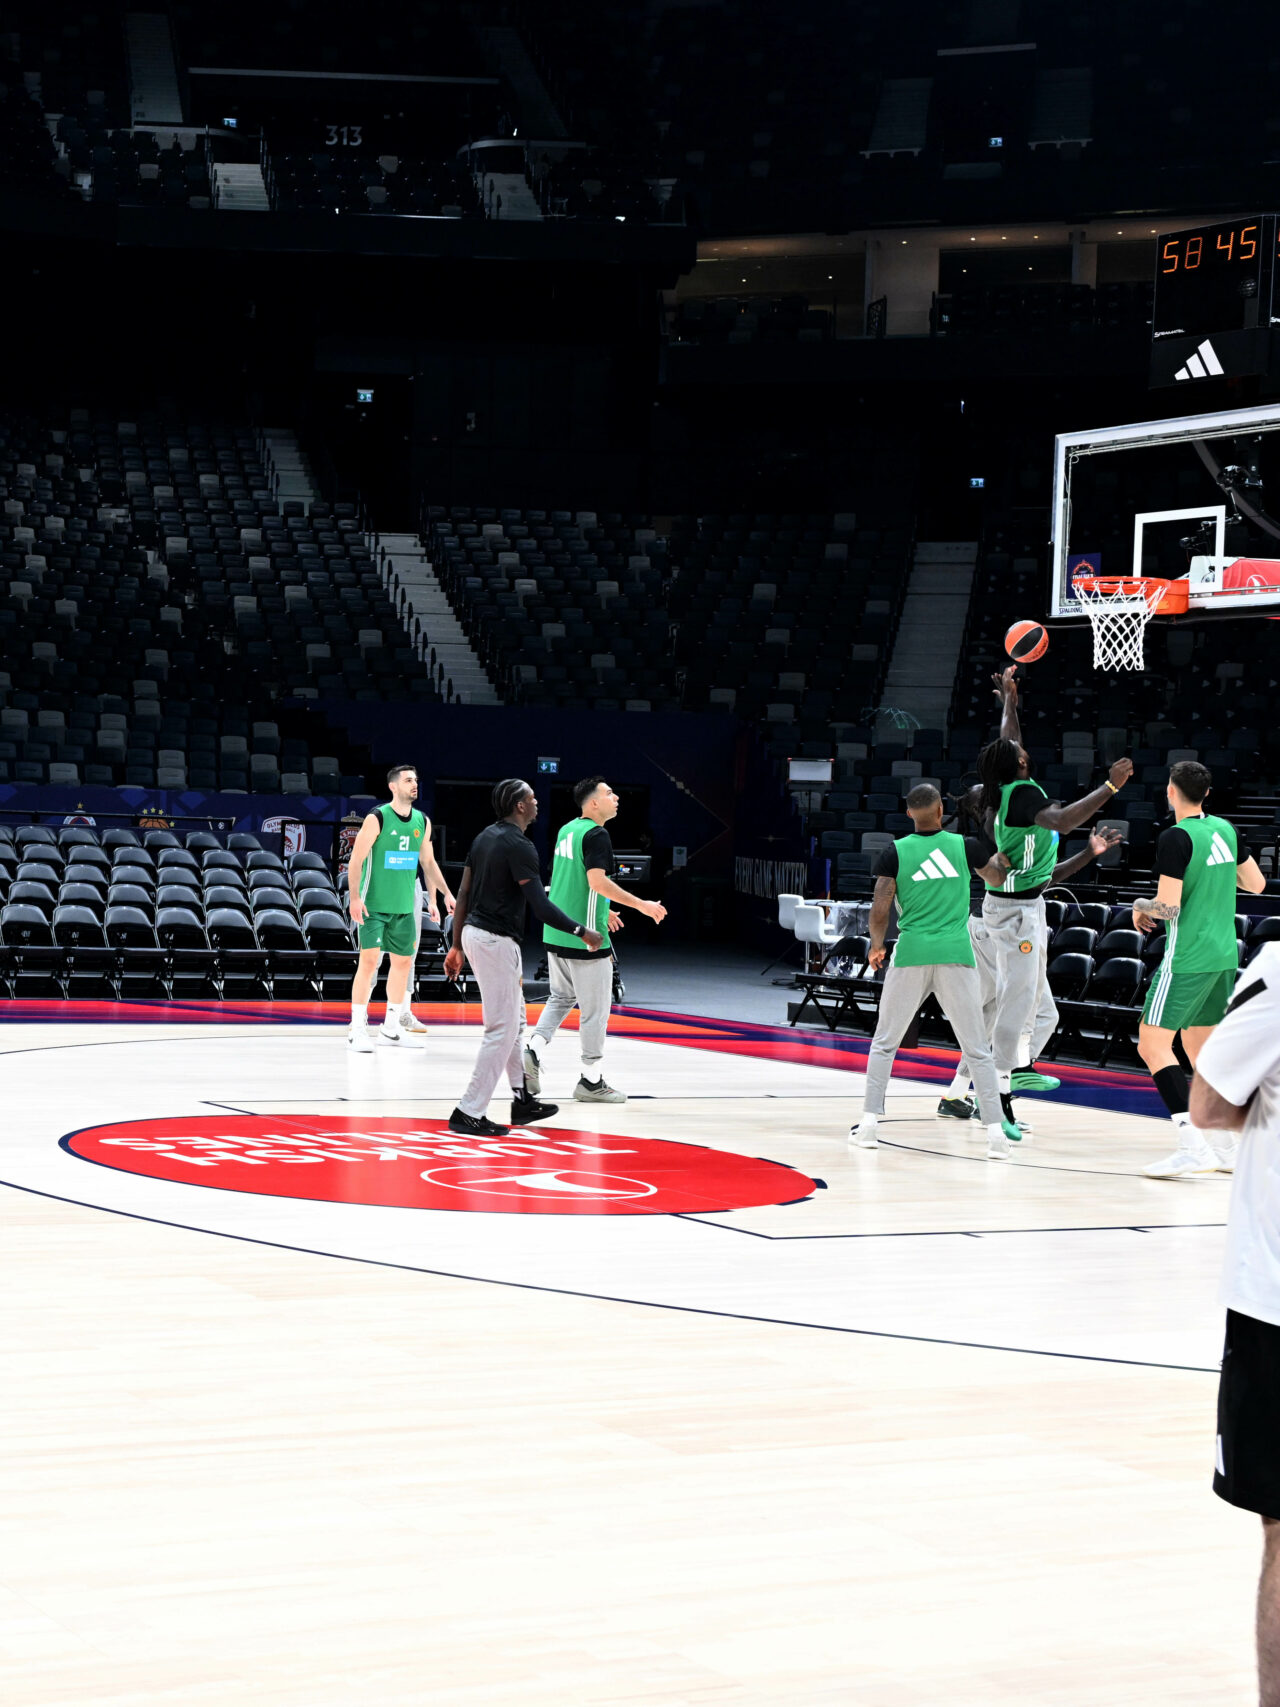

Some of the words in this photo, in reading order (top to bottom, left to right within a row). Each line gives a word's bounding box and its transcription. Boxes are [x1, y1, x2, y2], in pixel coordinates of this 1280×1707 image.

[326, 125, 362, 146] 313
[1163, 237, 1203, 273] 58
[1217, 226, 1257, 262] 45
[399, 836, 410, 851] 21
[99, 1129, 550, 1151] AIRLINES
[156, 1142, 639, 1166] TURKISH
